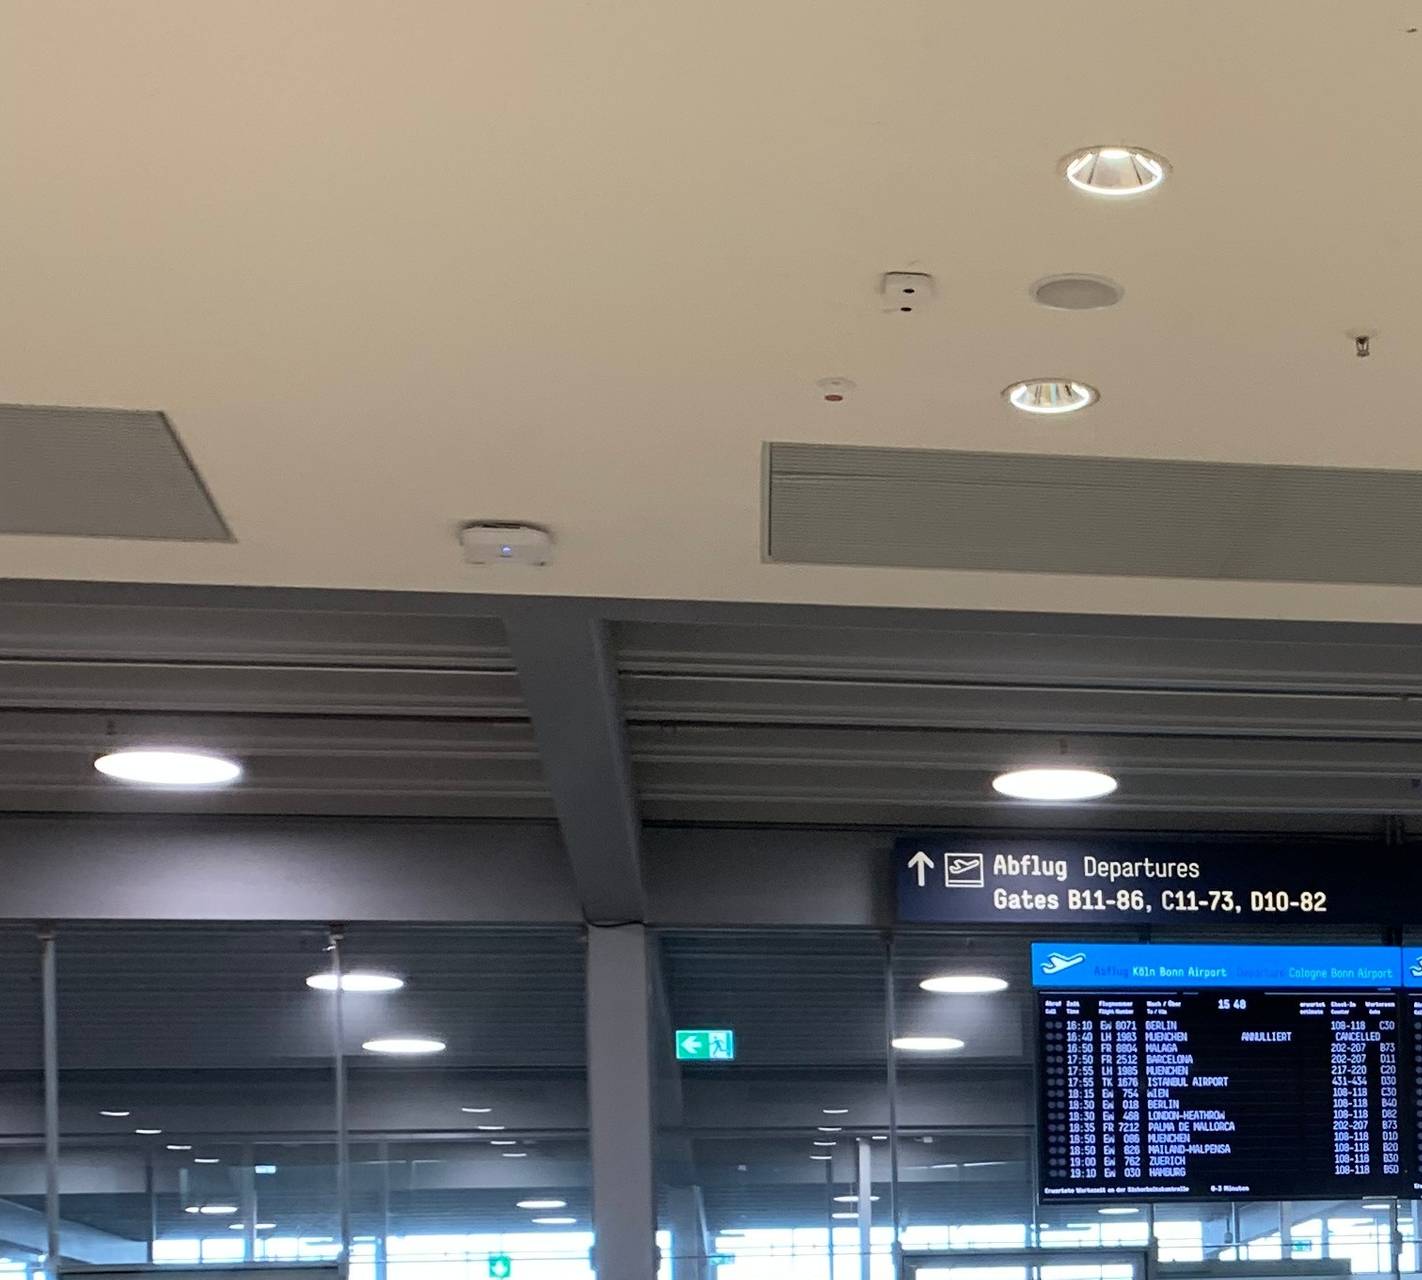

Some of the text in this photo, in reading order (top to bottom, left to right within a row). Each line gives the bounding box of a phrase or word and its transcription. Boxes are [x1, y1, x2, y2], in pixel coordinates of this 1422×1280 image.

[993, 854, 1200, 883] Abflug Departures
[993, 888, 1327, 913] Gates B11-86, C11-73, D10-82
[1132, 966, 1156, 977] Köln
[1160, 967, 1184, 977] Bonn
[1188, 966, 1227, 979] Airport
[1289, 968, 1327, 980] Cologne
[1331, 968, 1354, 978] Bonn
[1358, 968, 1393, 980] Airport
[1067, 1021, 1093, 1031] 16:10
[1146, 1021, 1178, 1031] BERLIN
[1331, 1021, 1366, 1031] 108-118
[1067, 1032, 1381, 1042] 16:40 LH MUENCHEN ANNULLIERT CANCELLED
[1068, 1043, 1367, 1054] 16:50 MALAGA 202-207
[1068, 1055, 1094, 1065] 17:50
[1101, 1055, 1112, 1064] FR
[1117, 1055, 1138, 1065] 2512
[1147, 1055, 1194, 1065] BARCELONA
[1331, 1054, 1367, 1064] 202-207
[1068, 1066, 1095, 1076] 17:55
[1146, 1066, 1189, 1076] MUENCHEN
[1331, 1065, 1367, 1075] 217-220
[1068, 1076, 1368, 1088] 17:55 TK ISTANBUL AIRPORT 431-434
[1069, 1089, 1095, 1099] 18:15
[1147, 1089, 1170, 1099] WIEN
[1333, 1088, 1368, 1098] 108-118
[1069, 1099, 1368, 1110] 18:30 018 BERLIN 108-118
[1069, 1110, 1369, 1122] 18:30 LONDON-HEATHROW 108-118
[1070, 1123, 1096, 1133] 18:35
[1103, 1122, 1114, 1131] FR
[1118, 1123, 1140, 1133] 7212
[1149, 1122, 1175, 1132] PALMA
[1179, 1122, 1190, 1132] DE
[1193, 1122, 1236, 1132] MALLORCA
[1333, 1121, 1369, 1131] 202-207
[1070, 1134, 1096, 1144] 18:50
[1148, 1134, 1191, 1144] MUENCHEN
[1334, 1132, 1369, 1142] 108-118
[1070, 1143, 1370, 1156] 18:50 MAILAND-MALPENSA 108-118
[1071, 1157, 1097, 1167] 19:00
[1150, 1156, 1186, 1166] ZUERICH
[1335, 1154, 1370, 1164] 108-118
[1071, 1169, 1097, 1179] 19:10
[1149, 1167, 1187, 1177] HAMBURG
[1335, 1165, 1371, 1175] 108-118
